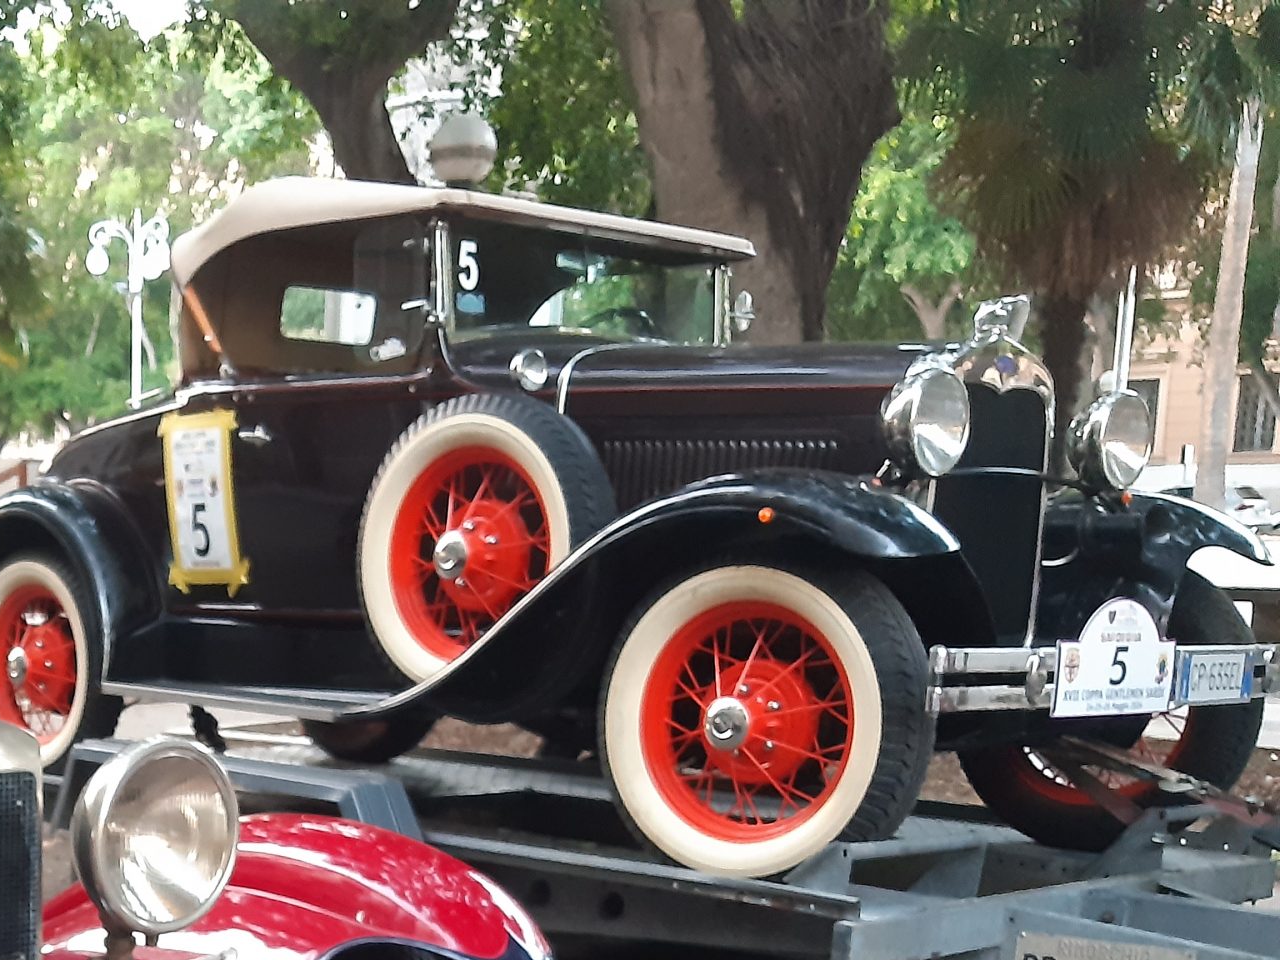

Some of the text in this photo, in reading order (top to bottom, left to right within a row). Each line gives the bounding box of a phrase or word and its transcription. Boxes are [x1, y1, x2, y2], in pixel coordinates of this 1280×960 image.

[458, 240, 480, 290] 5
[192, 503, 210, 557] 5
[1109, 646, 1129, 685] 5
